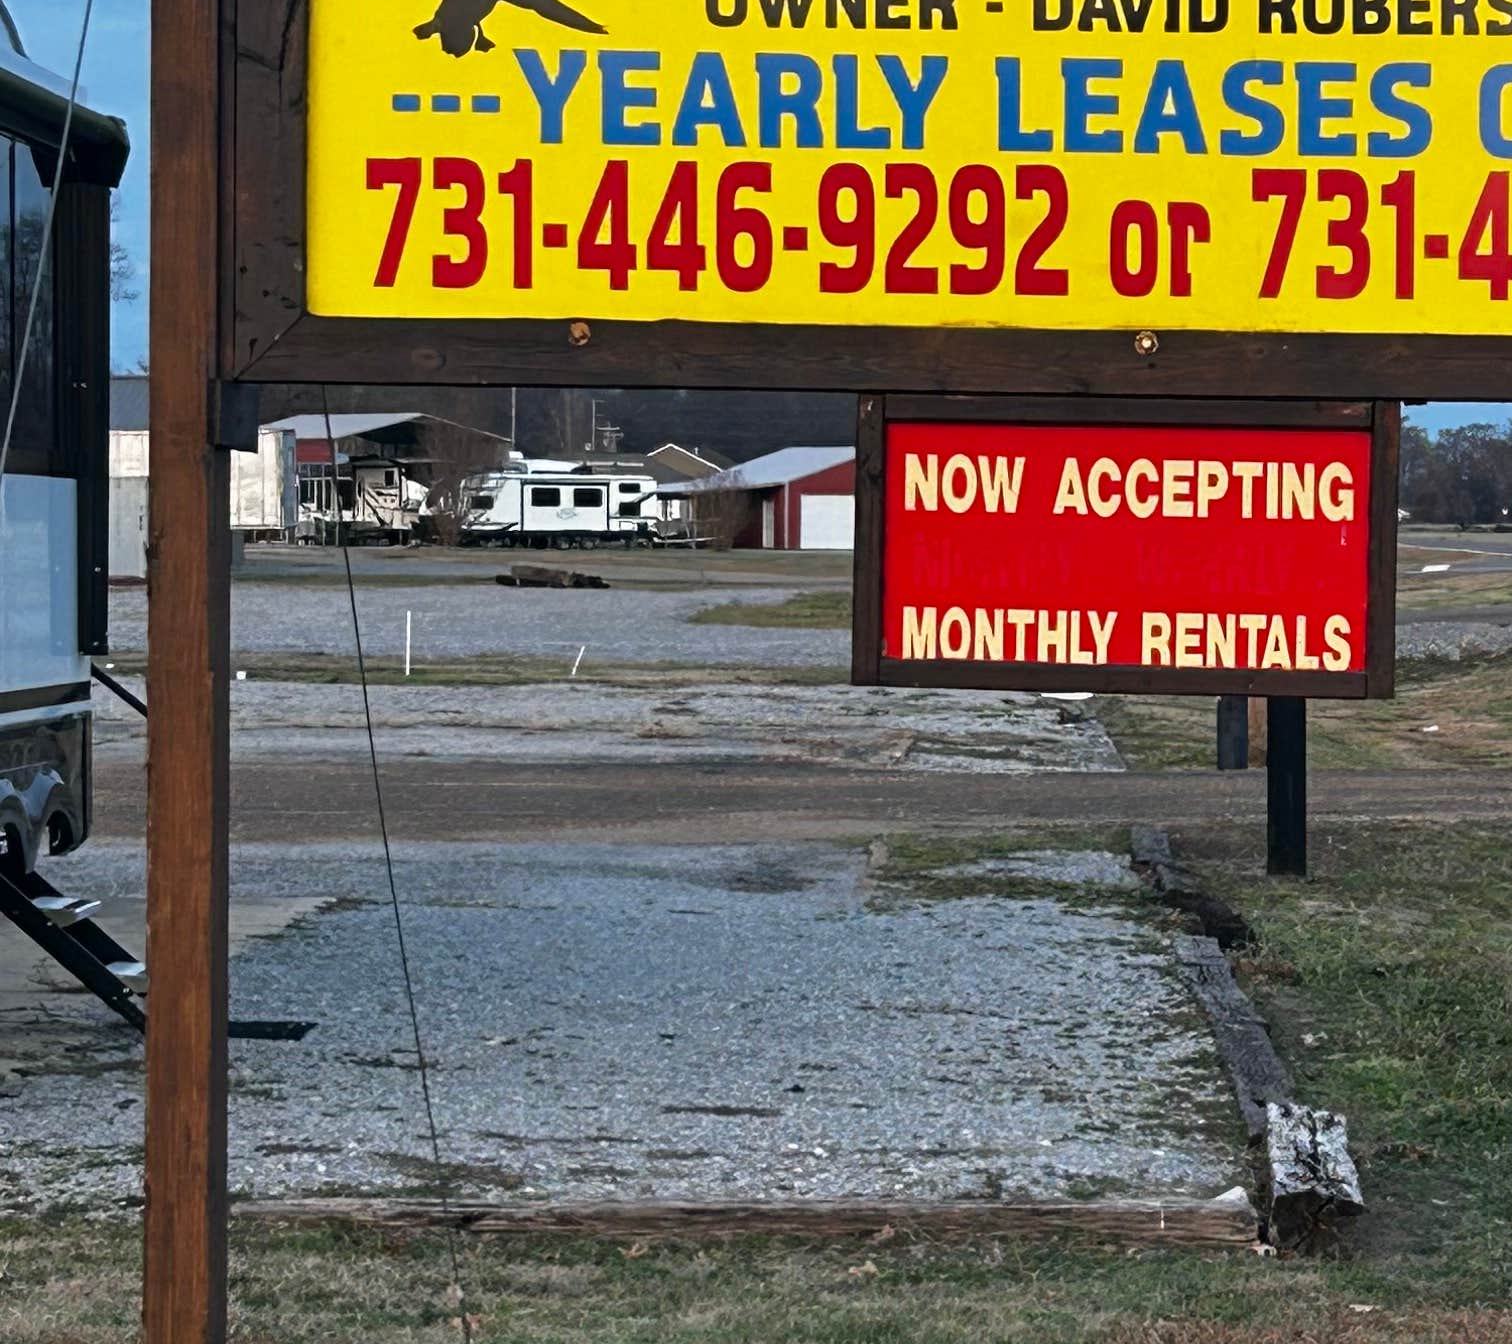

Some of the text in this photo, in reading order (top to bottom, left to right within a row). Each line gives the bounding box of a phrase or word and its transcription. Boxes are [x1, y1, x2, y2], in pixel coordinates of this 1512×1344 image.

[995, 56, 1433, 157] LEASES
[364, 156, 1070, 297] 731-446-9292
[1109, 199, 1212, 298] or
[904, 452, 1356, 523] NOW ACCEPTING
[902, 605, 1352, 672] MONTHLY RENTALS
